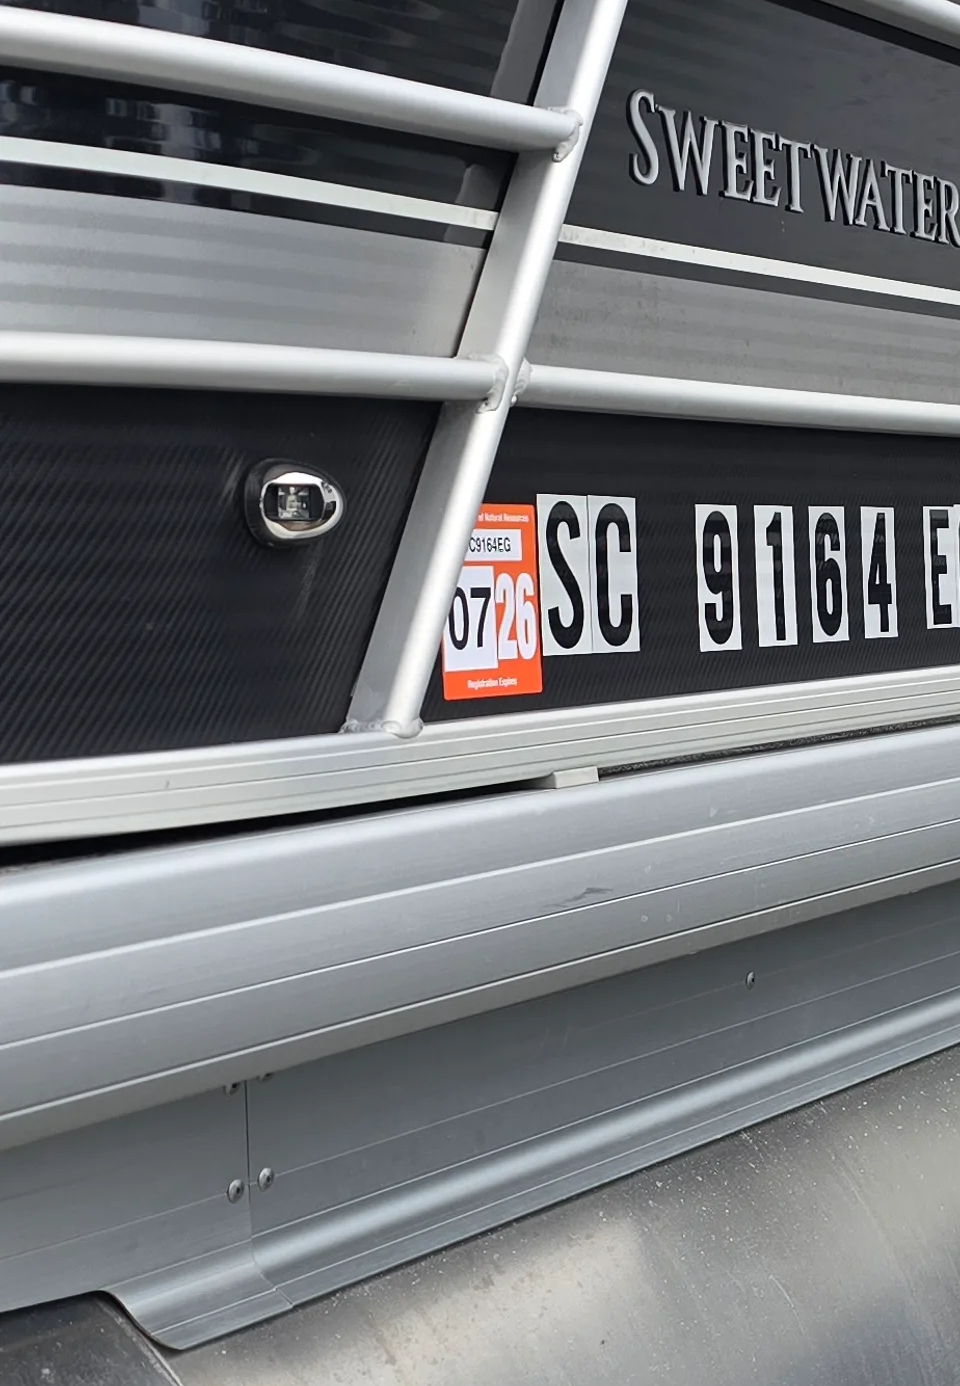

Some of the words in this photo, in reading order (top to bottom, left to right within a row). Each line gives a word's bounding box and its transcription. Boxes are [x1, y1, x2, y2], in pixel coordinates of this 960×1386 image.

[468, 537, 511, 553] C9164EG
[545, 500, 633, 649] SC
[702, 510, 892, 645] 9164
[450, 587, 492, 651] 07
[495, 572, 537, 660] 26
